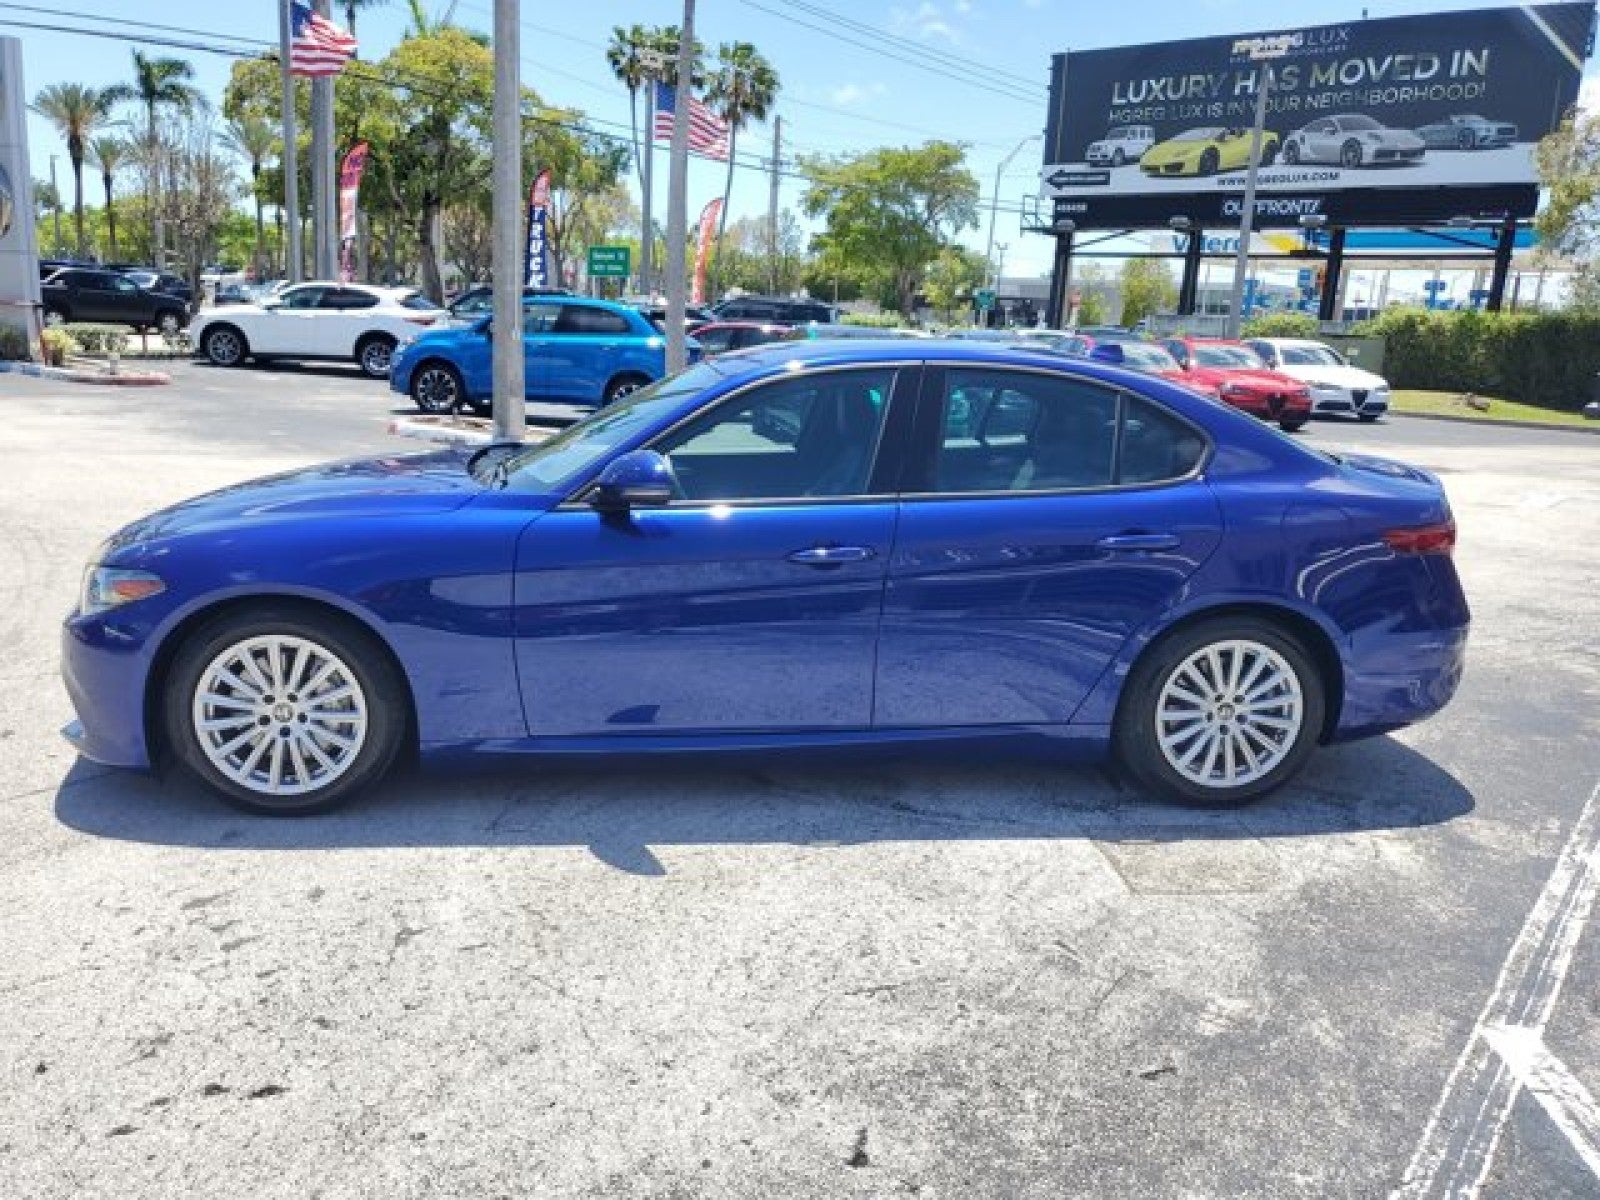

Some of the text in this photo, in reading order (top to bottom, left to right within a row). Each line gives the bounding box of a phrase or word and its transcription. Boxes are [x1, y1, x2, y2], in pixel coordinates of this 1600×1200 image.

[1111, 73, 1229, 106] LUXURY
[1233, 64, 1301, 97] HAS
[1308, 53, 1441, 89] MOVED
[1450, 49, 1489, 78] IN
[1109, 105, 1167, 123] HGREG
[1170, 104, 1203, 121] LUX
[1206, 102, 1224, 118] IS
[1226, 100, 1245, 116] IN
[1304, 81, 1487, 110] NEIGHBORHOOD!
[1216, 171, 1340, 186] WWWGREGLUX.COM
[1223, 199, 1320, 216] OFRONT/
[529, 206, 546, 288] TRUCK
[1173, 235, 1242, 252] Vler
